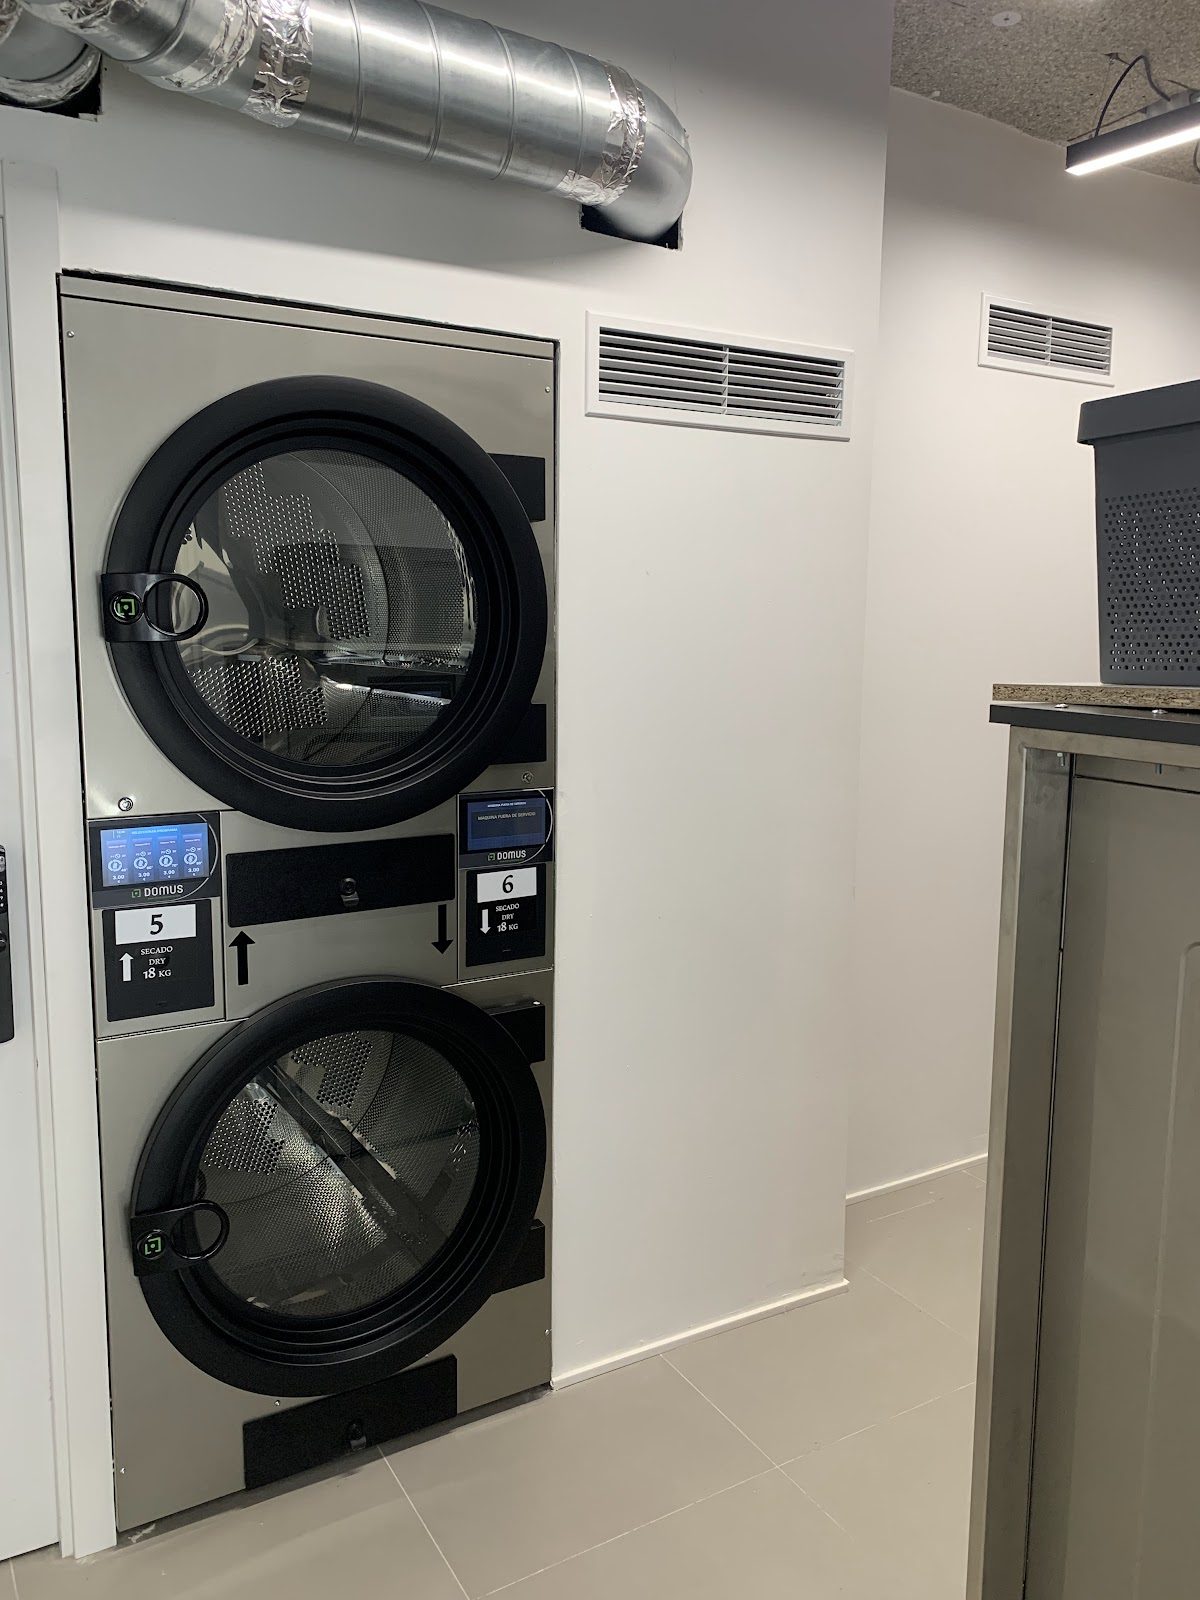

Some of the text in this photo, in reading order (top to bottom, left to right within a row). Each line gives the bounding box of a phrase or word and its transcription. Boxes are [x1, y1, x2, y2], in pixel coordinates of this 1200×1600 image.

[497, 849, 527, 860] DOMUS
[502, 874, 514, 894] 6
[144, 884, 184, 897] DOMUS
[495, 903, 520, 912] SECADO
[501, 913, 515, 921] DRY
[149, 913, 164, 936] 5
[497, 921, 519, 933] 18 KG
[140, 945, 173, 956] SECADO
[148, 957, 166, 966] DRY
[142, 967, 172, 979] 18 KG
